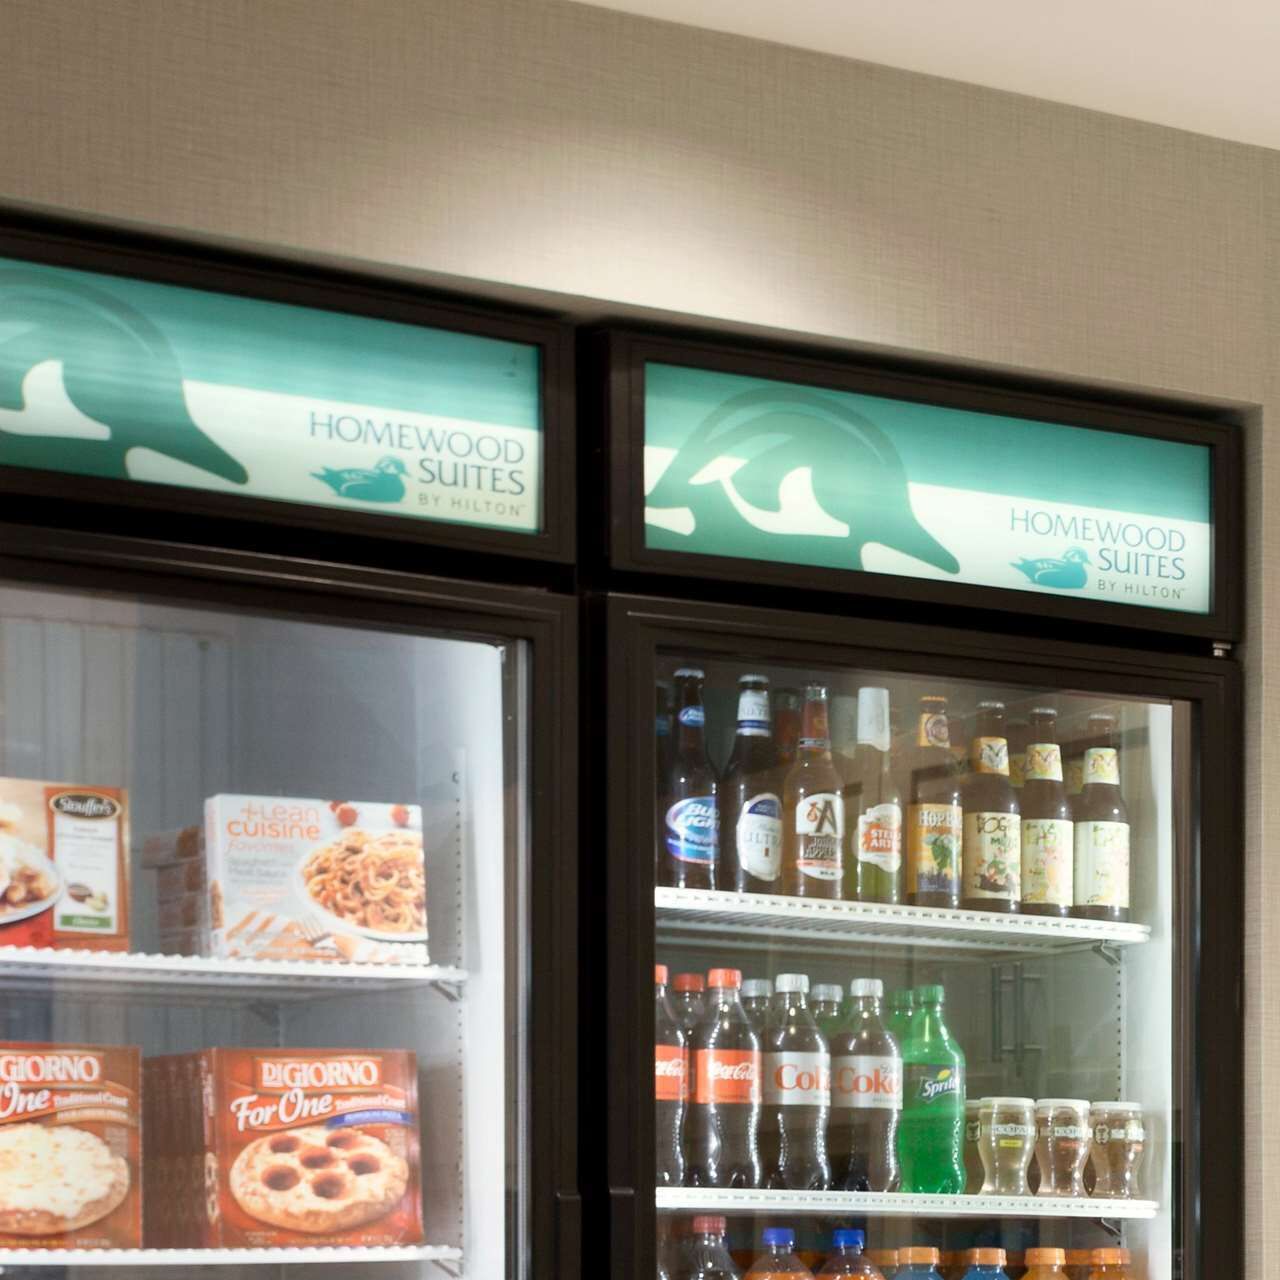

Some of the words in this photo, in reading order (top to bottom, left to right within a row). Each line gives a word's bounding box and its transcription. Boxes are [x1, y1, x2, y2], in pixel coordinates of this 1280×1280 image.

[310, 410, 525, 464] HOMEWOOD
[418, 457, 525, 496] SUITES
[418, 493, 441, 507] BY
[451, 497, 519, 518] HILTON
[1010, 507, 1186, 553] HOMEWOOD
[1098, 548, 1186, 581] SUITES
[1098, 580, 1116, 592] BY
[1124, 584, 1182, 599] HILTON
[0, 1056, 100, 1083] GIORNO
[230, 1094, 278, 1132] For
[278, 1087, 333, 1123] One
